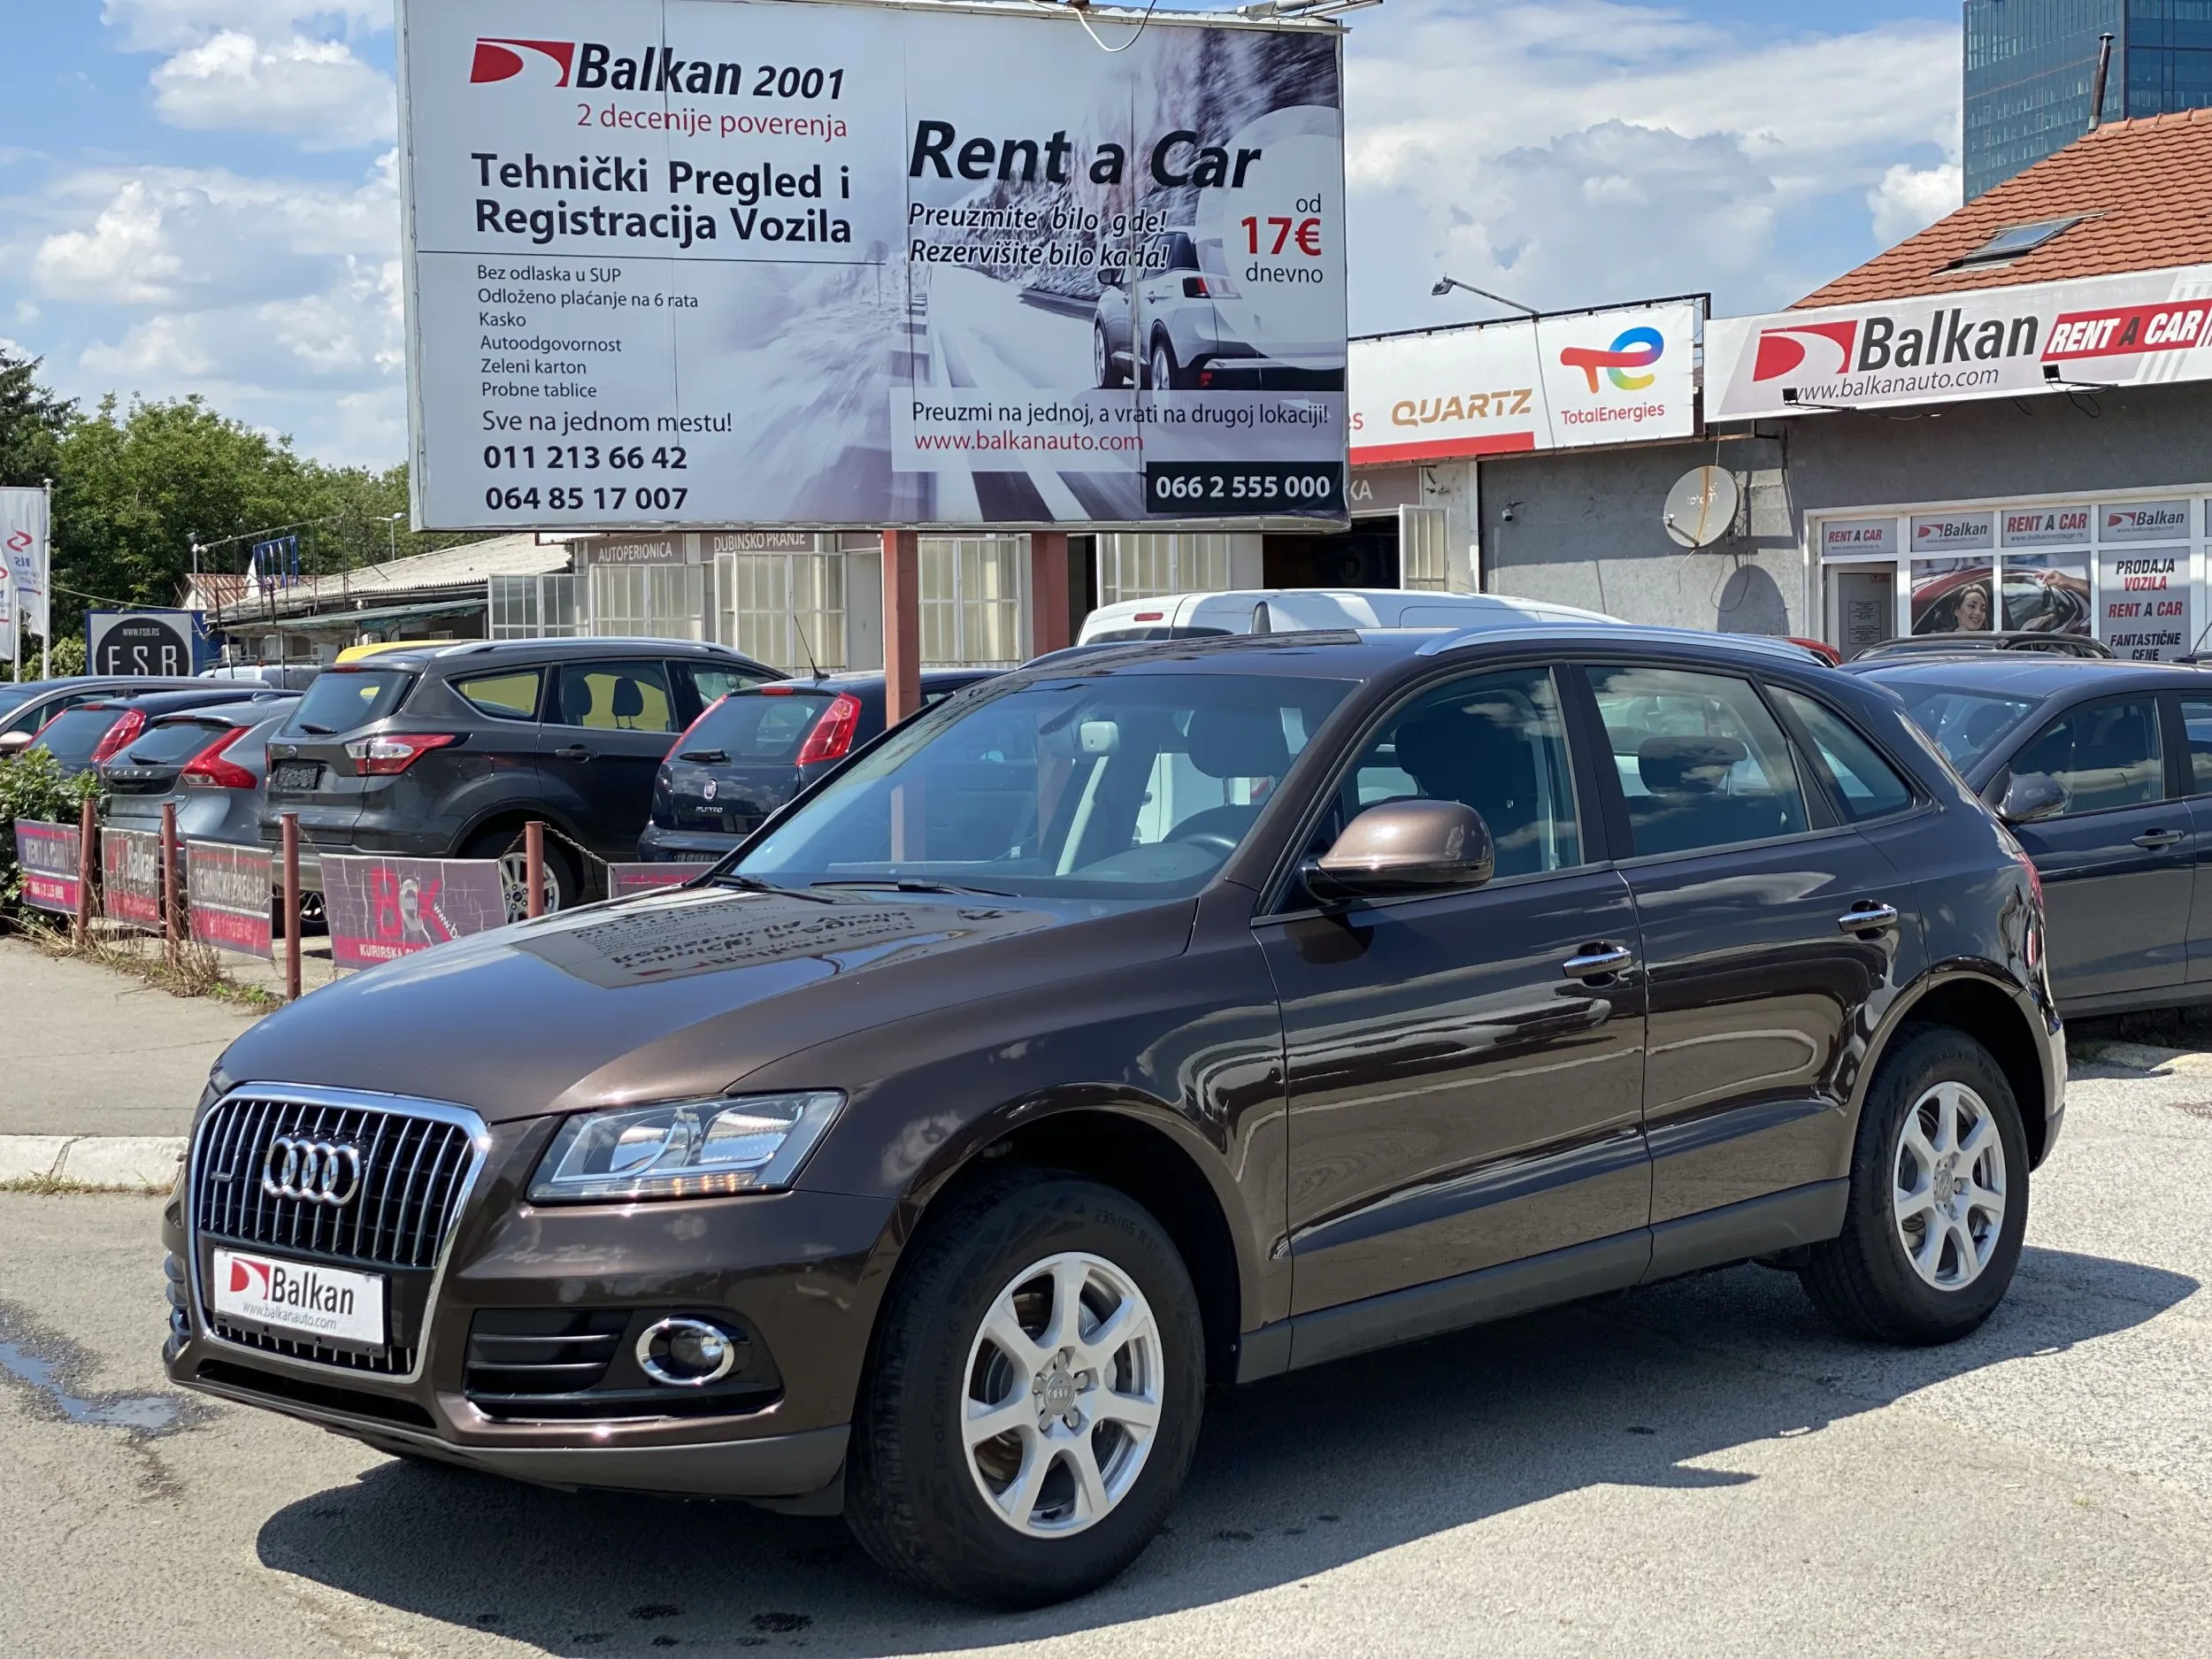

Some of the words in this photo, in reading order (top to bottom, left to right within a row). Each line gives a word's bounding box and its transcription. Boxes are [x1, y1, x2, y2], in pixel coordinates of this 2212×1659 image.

[576, 42, 741, 96] Balkan
[753, 65, 844, 100] 2001
[577, 104, 592, 127] 2
[600, 104, 711, 136] decenije
[720, 113, 848, 142] poverenja
[909, 119, 1071, 184] Rent
[1088, 142, 1125, 185] a
[1150, 129, 1263, 188] Car
[471, 153, 649, 192] Tehnički
[669, 160, 822, 205] Pregled
[841, 165, 850, 199] i
[1296, 194, 1322, 213] od
[476, 199, 717, 250] Registracija
[730, 208, 851, 242] Vozila
[909, 204, 1038, 230] Preuzmite
[1052, 206, 1099, 233] bilo
[1112, 210, 1168, 238] gde!
[1241, 216, 1322, 257] 17€
[910, 239, 1041, 265] Rezervišite
[1048, 242, 1094, 266] bilo
[1099, 243, 1171, 269] kada!
[477, 265, 506, 280] Bez
[510, 266, 572, 281] odlaska
[576, 270, 586, 281] u
[589, 267, 621, 282] SUP
[1246, 263, 1324, 284] dnevno
[478, 288, 557, 305] Odloženo
[560, 290, 627, 309] plaćanje
[631, 295, 650, 307] na
[654, 293, 664, 307] 6
[668, 293, 699, 308] rata
[479, 311, 526, 327] Kasko
[1857, 308, 2039, 372] Balkan
[2047, 318, 2122, 354] RENT
[2116, 317, 2141, 347] A
[2144, 310, 2204, 344] CAR
[480, 335, 622, 354] Autoodgovornost
[480, 358, 531, 373] Zeleni
[534, 359, 587, 375] karton
[481, 381, 540, 397] Probne
[543, 382, 597, 398] tablice
[913, 402, 992, 421] Preuzmi
[999, 406, 1021, 422] na
[1025, 403, 1094, 427] jednoj,
[1099, 408, 1110, 423] a
[1115, 404, 1158, 423] vrati
[1164, 408, 1186, 423] na
[1191, 403, 1255, 428] drugoj
[1259, 404, 1329, 428] lokaciji!
[1392, 388, 1533, 427] QUARTZ
[1561, 401, 1665, 426] TotalEnergies
[482, 411, 522, 431] Sve
[529, 416, 557, 432] na
[562, 411, 649, 436] jednom
[657, 411, 733, 433] mestu!
[915, 429, 1144, 451] www.balkanauto.com
[483, 445, 535, 469] 011
[547, 445, 600, 470] 213
[608, 446, 645, 470] 66
[651, 446, 687, 470] 42
[1156, 475, 1203, 498] 066
[1210, 476, 1225, 498] 2
[1231, 475, 1279, 498] 555
[1284, 475, 1330, 498] 000
[485, 487, 541, 510] 064
[549, 487, 584, 510] 85
[593, 487, 627, 510] 17
[634, 487, 688, 510] 007
[1944, 522, 1987, 537] Balkan
[2007, 516, 2043, 533] RENT
[2045, 514, 2055, 531] A
[2059, 512, 2087, 529] CAR
[2137, 511, 2184, 526] Balkan
[714, 534, 765, 551] DUBINSKO
[766, 533, 806, 547] PRANJE
[1828, 531, 1853, 542] RENT
[1854, 530, 1861, 541] A
[1863, 529, 1883, 541] CAR
[598, 541, 672, 563] AUTOPERIONICA
[2116, 558, 2175, 574] PRODAJA
[2124, 576, 2167, 591] VOZILA
[2108, 603, 2141, 618] RENT
[2144, 603, 2153, 617] A
[2156, 602, 2183, 617] CAR
[122, 627, 160, 636] WWW.FSB.RS
[2110, 630, 2182, 647] FANTASTIČNE
[434, 902, 461, 939] www.b
[359, 943, 403, 959] KURIRSKA
[273, 1266, 355, 1315] Balkan
[243, 1301, 337, 1330] www.balkanauto.com
